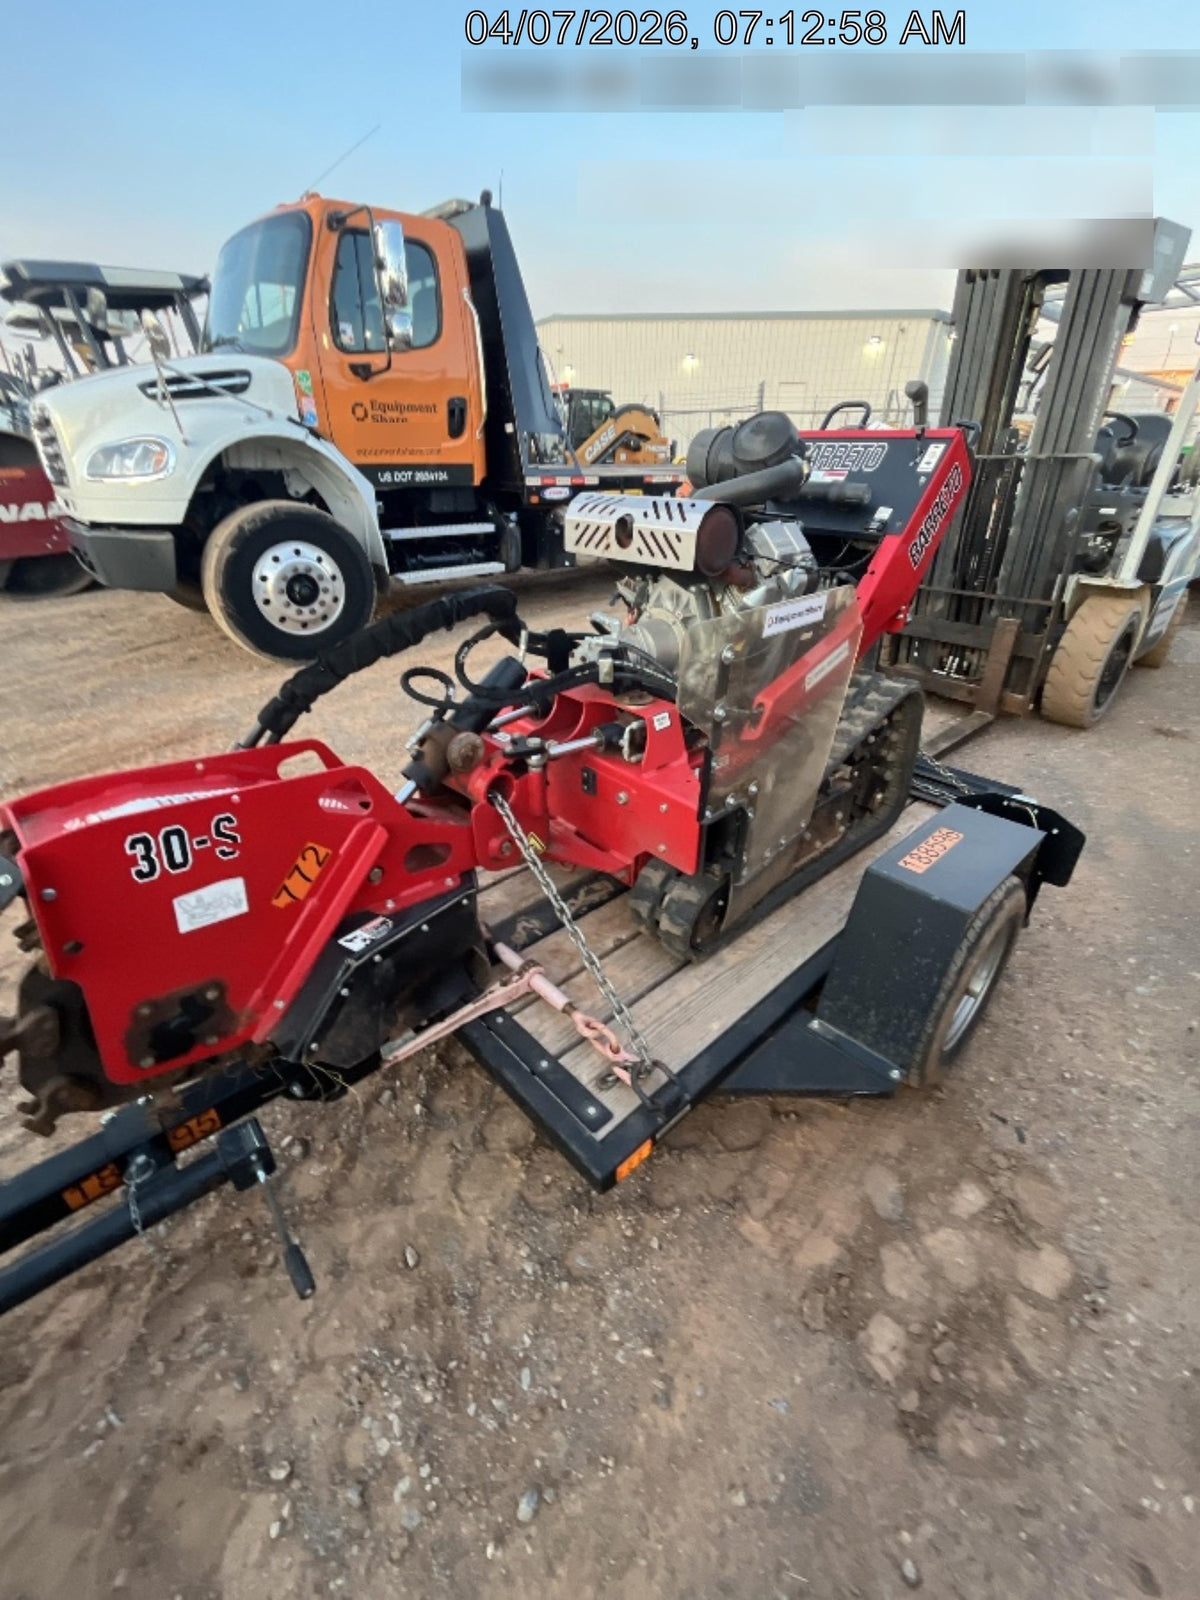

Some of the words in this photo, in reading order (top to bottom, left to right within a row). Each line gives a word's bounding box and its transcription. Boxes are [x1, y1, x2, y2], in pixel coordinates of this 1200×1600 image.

[369, 400, 438, 414] Equipment
[371, 414, 408, 423] Share
[585, 425, 616, 460] CASE
[394, 471, 413, 482] DOT
[909, 462, 963, 570] BARRETO
[125, 812, 241, 883] 30-S
[274, 846, 329, 901] 772
